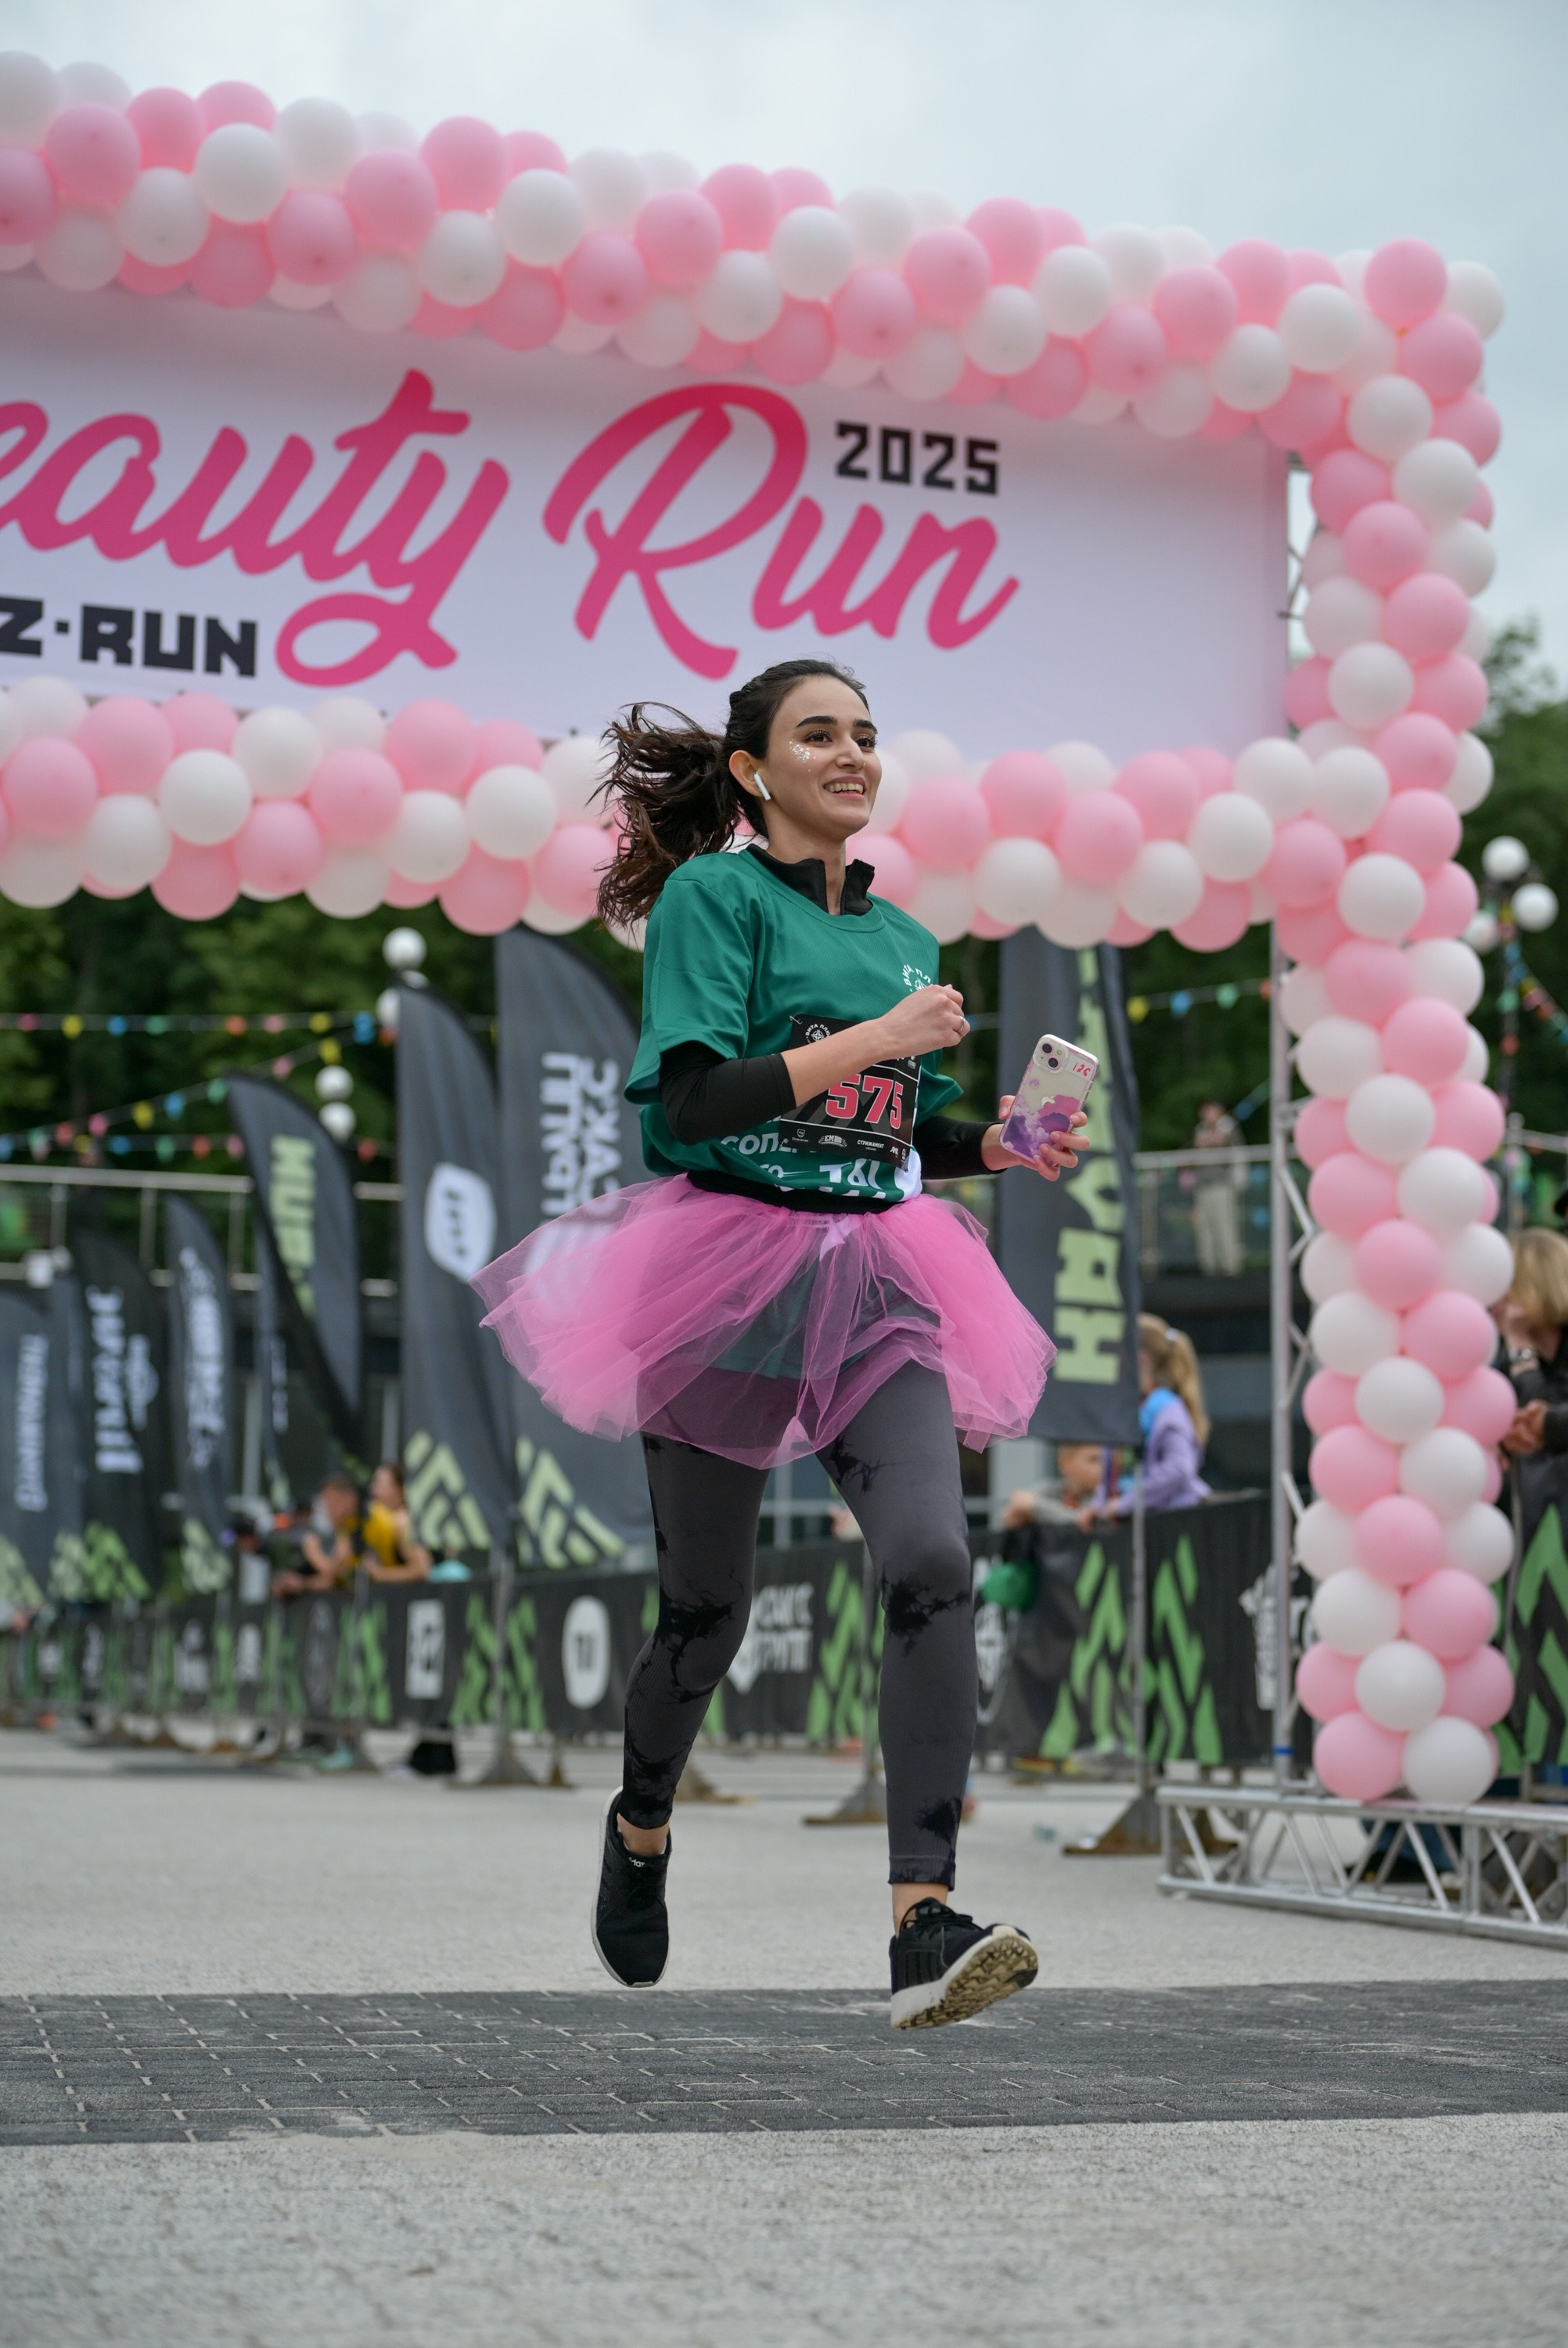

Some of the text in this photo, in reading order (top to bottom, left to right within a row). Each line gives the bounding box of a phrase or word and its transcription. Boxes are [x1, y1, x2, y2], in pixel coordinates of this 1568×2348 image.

[834, 420, 999, 496] 2025
[541, 381, 1020, 681] Run
[825, 1073, 904, 1129] 575
